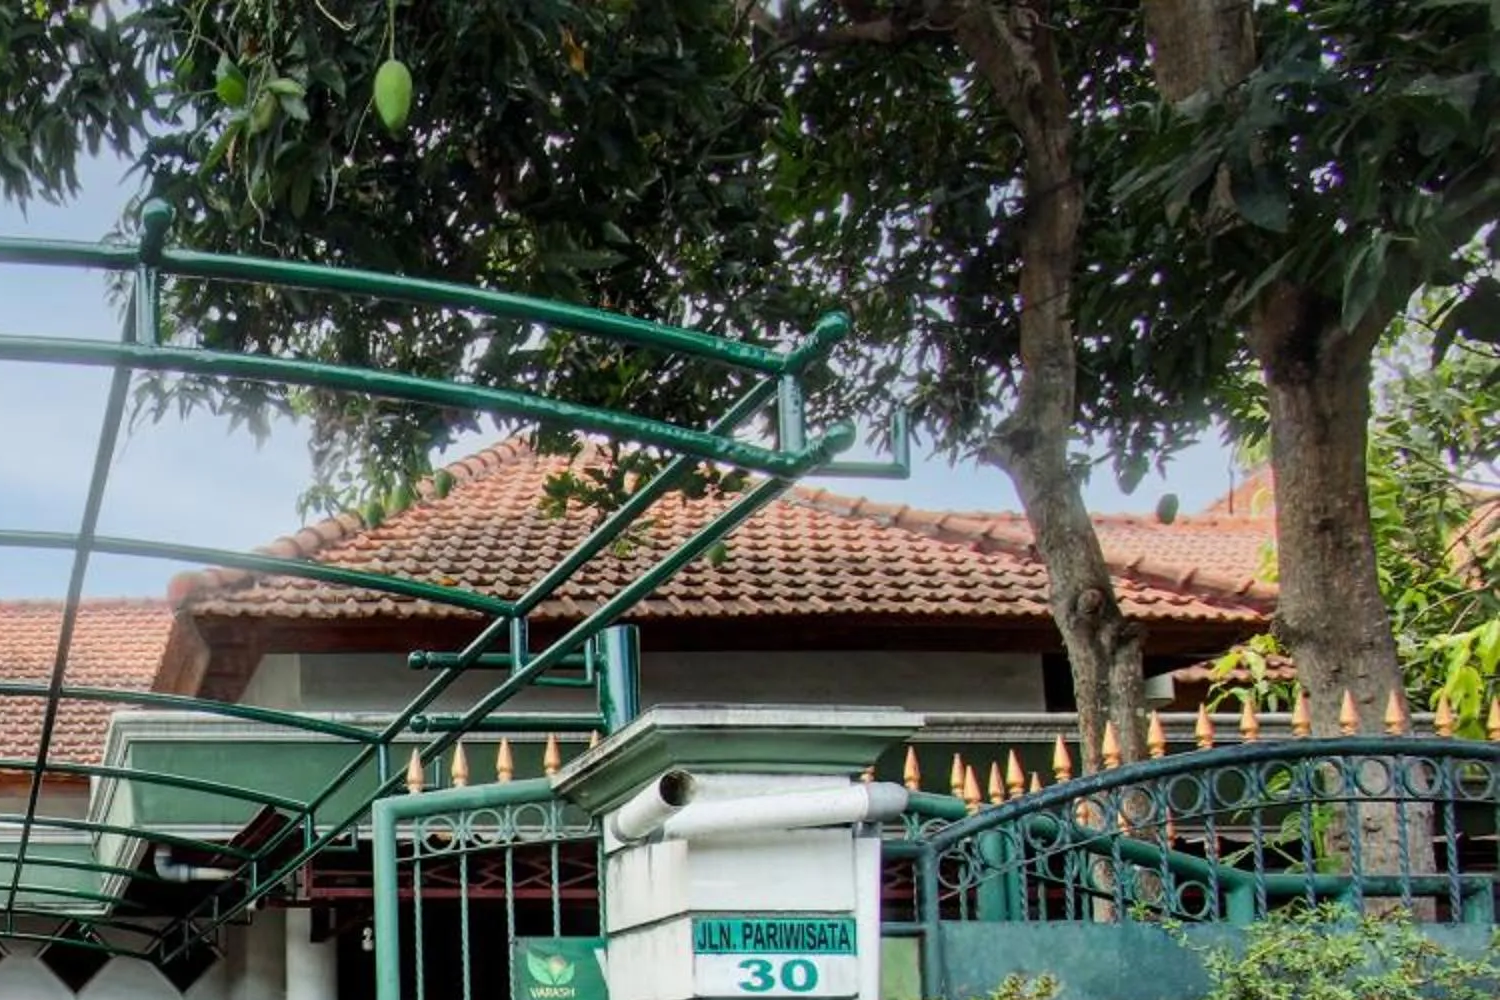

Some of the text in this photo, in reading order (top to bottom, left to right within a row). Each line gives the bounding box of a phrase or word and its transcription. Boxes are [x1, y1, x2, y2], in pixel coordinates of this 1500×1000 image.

[697, 922, 851, 951] JLN. PARIWISATA
[737, 958, 819, 993] 30
